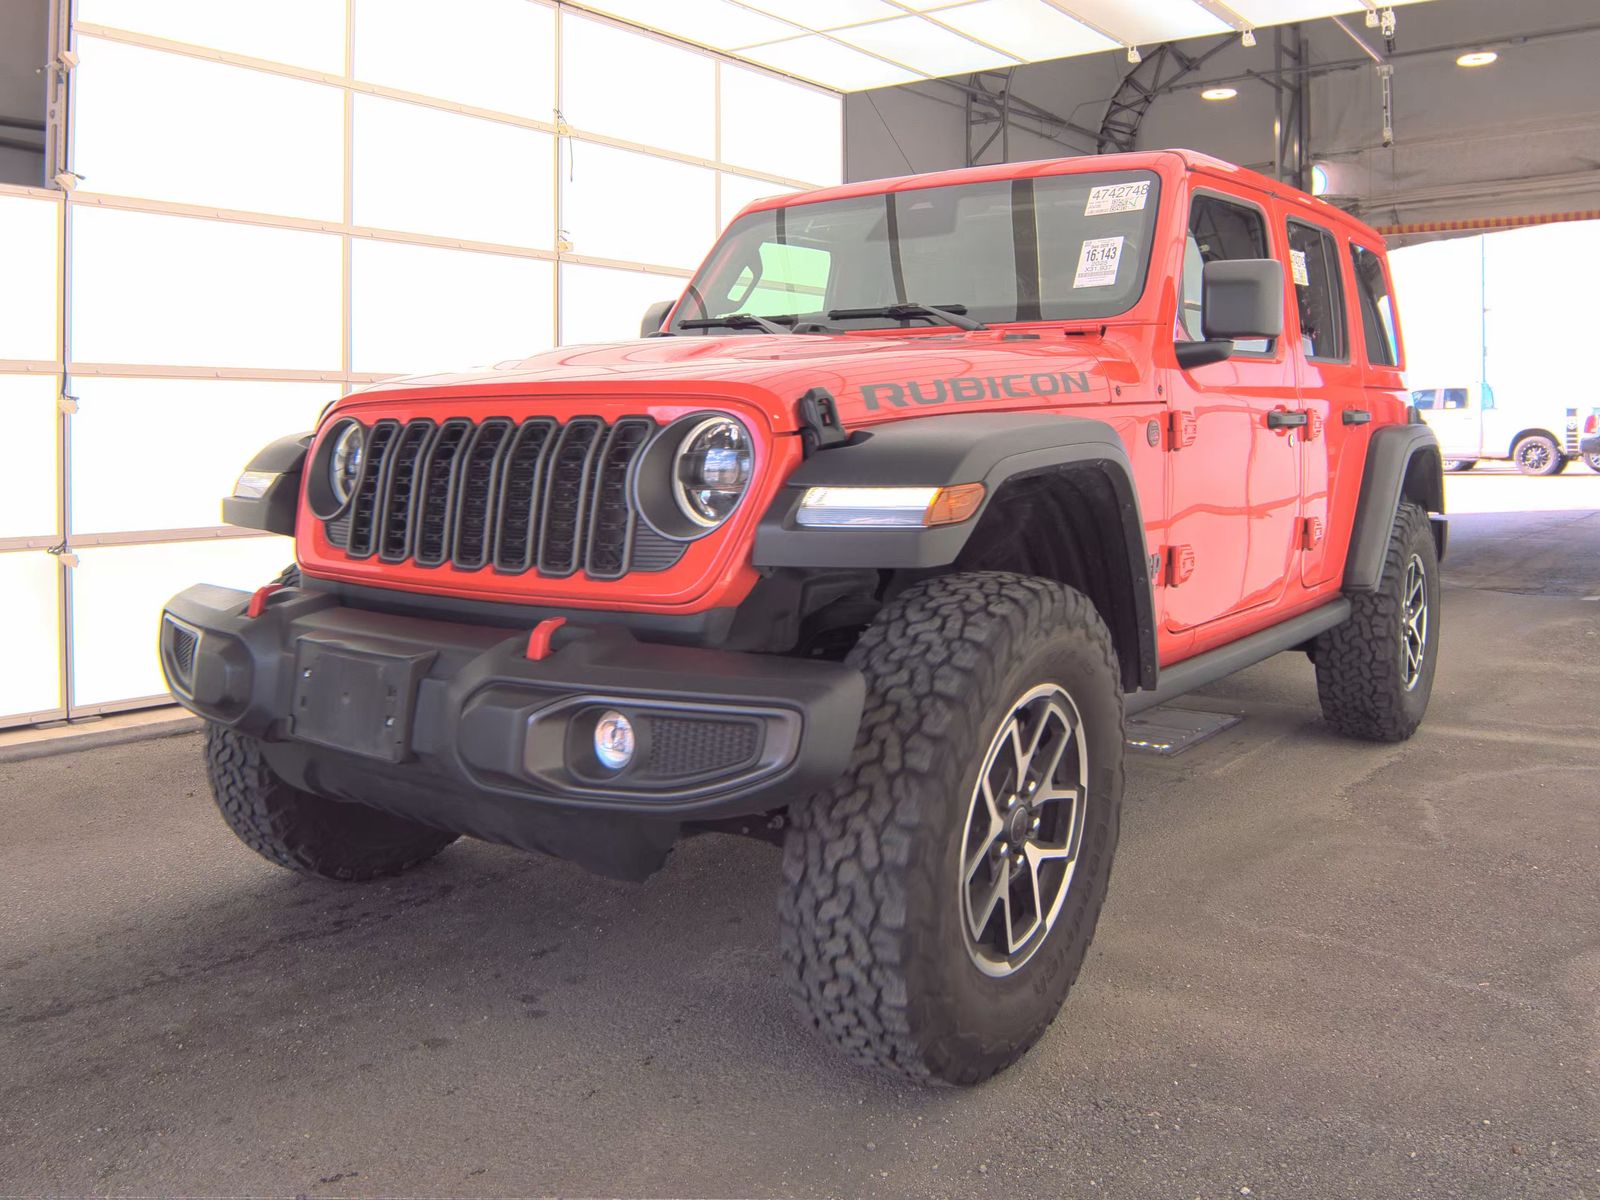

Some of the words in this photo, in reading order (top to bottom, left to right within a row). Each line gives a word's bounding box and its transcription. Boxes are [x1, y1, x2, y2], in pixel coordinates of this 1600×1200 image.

[1092, 184, 1150, 200] 4742748
[1086, 247, 1117, 262] 16:143
[859, 371, 1090, 411] RUBICON
